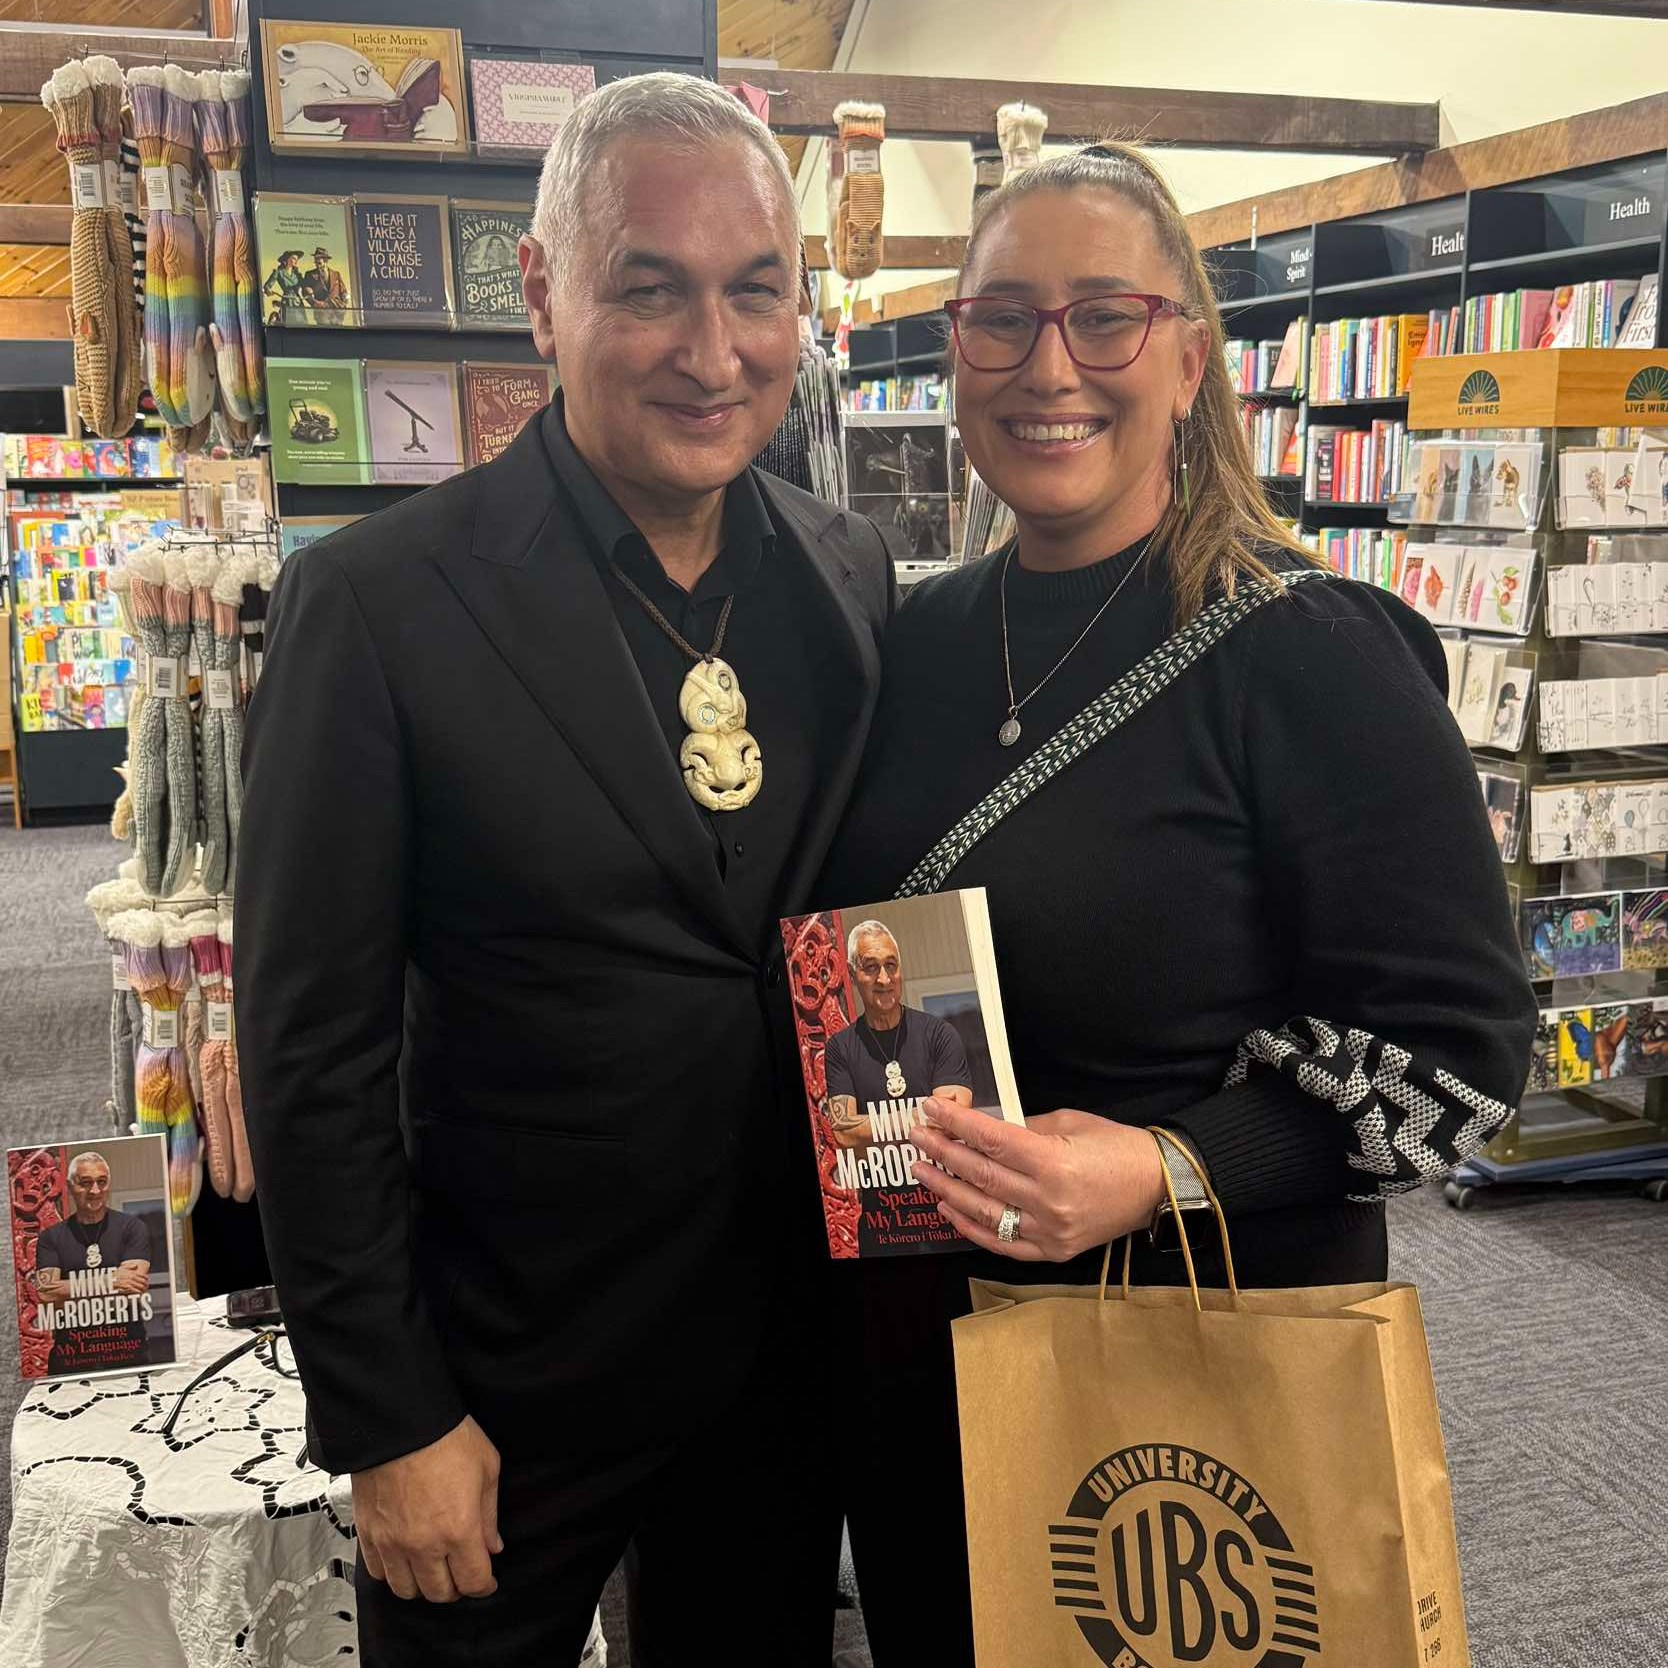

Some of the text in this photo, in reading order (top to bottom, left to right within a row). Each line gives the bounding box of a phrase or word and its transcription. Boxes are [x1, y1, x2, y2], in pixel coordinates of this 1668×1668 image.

[353, 33, 428, 45] Jackie Morris
[1610, 196, 1650, 220] Health
[366, 213, 418, 227] I HEAR IT
[367, 226, 416, 240] TAKES A
[461, 219, 522, 241] HAPPINES
[367, 239, 417, 253] VILLAGE
[1431, 231, 1465, 257] Healt
[368, 252, 423, 267] TO RAISE
[370, 266, 419, 280] A CHILD.
[1286, 265, 1306, 282] Spirit
[466, 280, 512, 304] BOOKS
[490, 292, 525, 312] SMEL
[501, 378, 532, 395] FORM
[510, 389, 540, 406] GANG
[1457, 404, 1500, 416] LIVE WIRES
[1624, 402, 1645, 413] LIVE
[836, 1143, 944, 1190] McROB
[878, 1188, 941, 1211] Speaki
[866, 1209, 949, 1231] My Lang
[69, 1266, 120, 1299] MIKE
[37, 1292, 153, 1332] McROBERTS
[69, 1325, 128, 1343] Speaking
[80, 1339, 141, 1354] Language
[1088, 1447, 1268, 1523] UNIVERSITY
[1111, 1500, 1260, 1661] UBS
